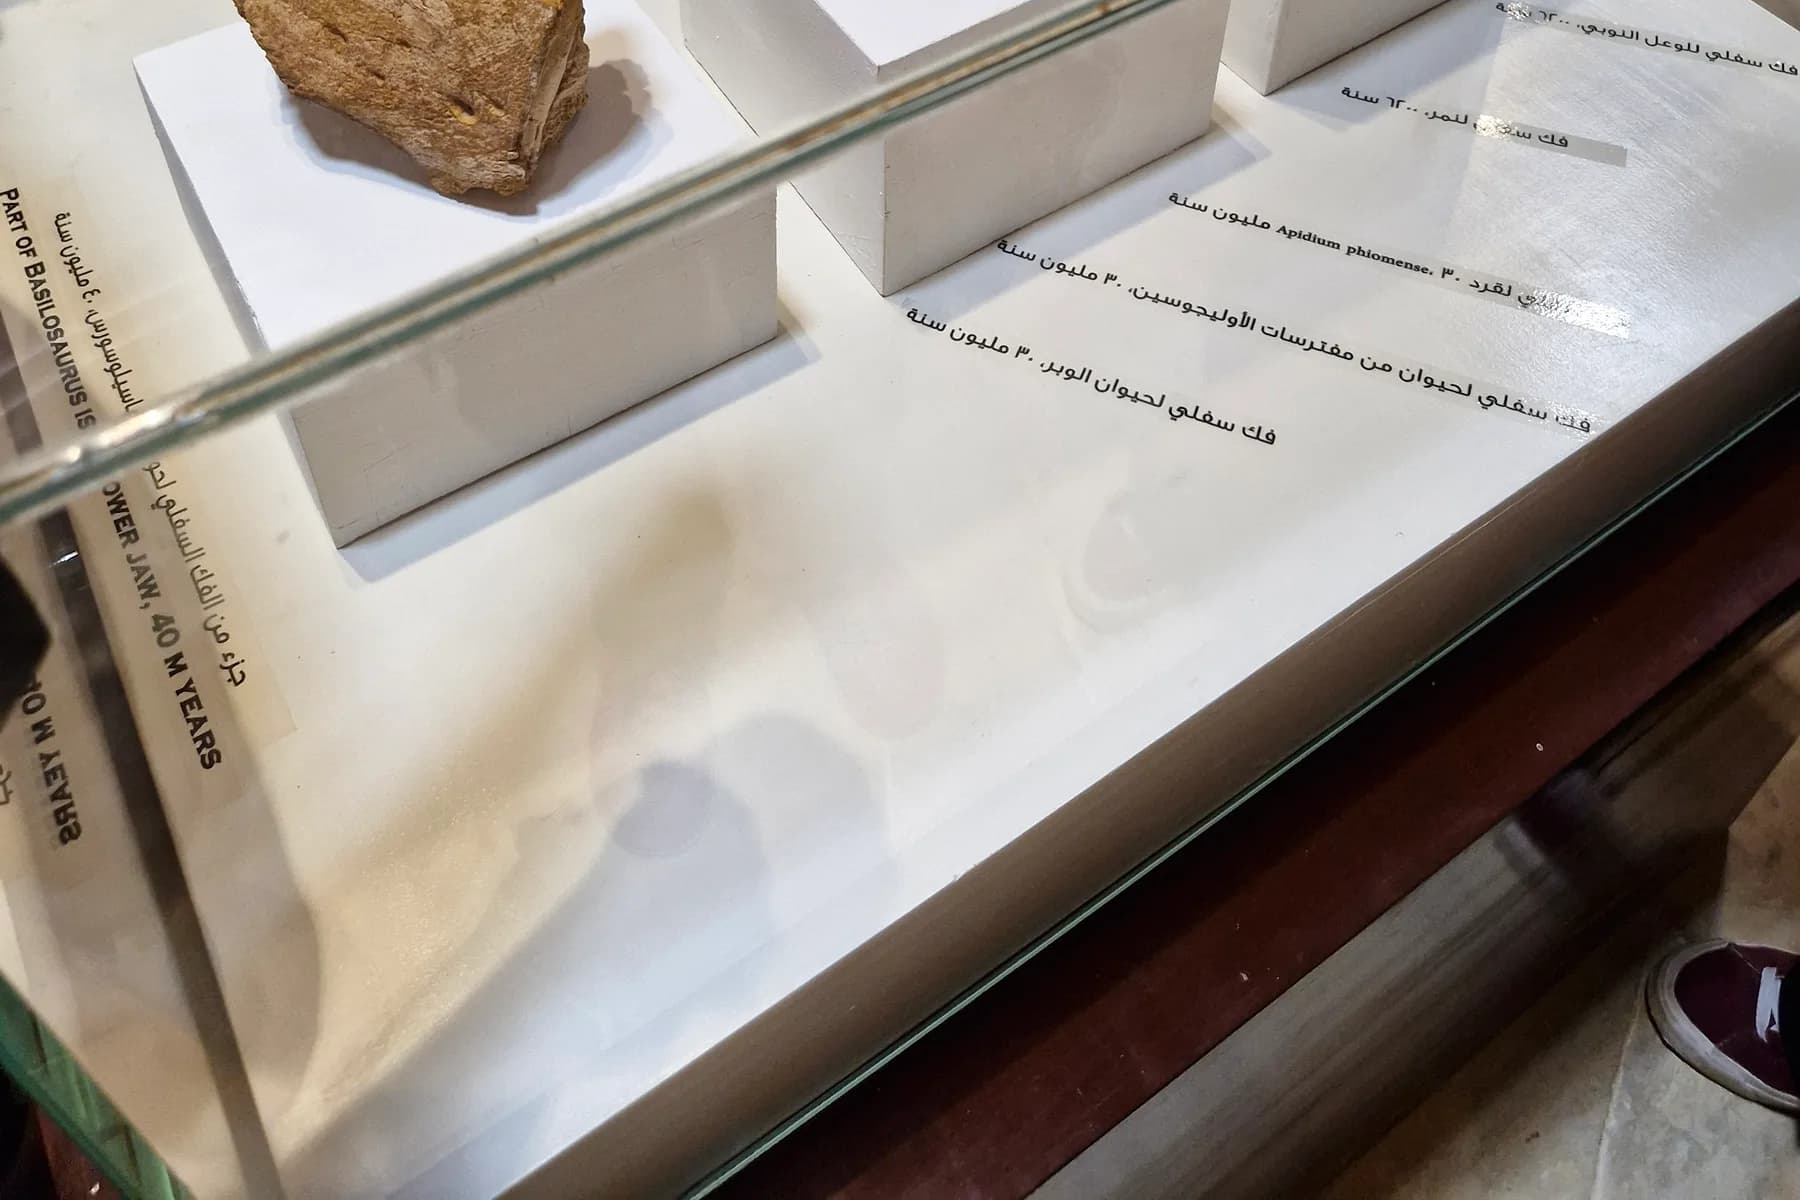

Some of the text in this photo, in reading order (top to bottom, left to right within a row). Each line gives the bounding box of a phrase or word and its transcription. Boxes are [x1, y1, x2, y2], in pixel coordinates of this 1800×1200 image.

[1644, 35, 1700, 54] للوعل
[1705, 50, 1763, 69] سفلي
[1768, 60, 1800, 77] فك
[1341, 85, 1380, 105] سنة
[1386, 96, 1418, 112] ٦٢٠٠
[1538, 132, 1569, 149] فك
[0, 187, 28, 233] PART
[1168, 191, 1208, 213] سنة
[54, 211, 74, 243] سنة
[1212, 207, 1271, 231] مليون
[16, 236, 37, 259] OF
[997, 238, 1036, 262] سنة
[1275, 224, 1341, 251] Apidium
[59, 244, 94, 288] مليون
[1039, 256, 1098, 281] مليون
[1103, 272, 1122, 287] ٣٠
[1441, 266, 1461, 282] ٣٠
[1468, 279, 1513, 297] لقرد
[906, 306, 948, 332] سنة
[24, 260, 88, 407] BASILOSAURUS
[949, 325, 1010, 355] مليون
[1260, 322, 1354, 361] مفترسات
[84, 308, 144, 412] اسيلوسورس،
[1014, 345, 1034, 362] ٣٠
[1359, 354, 1393, 373] من
[1094, 375, 1166, 409] لحيوان
[1398, 367, 1473, 397] لحيوان
[1168, 403, 1235, 433] سفلي
[1477, 393, 1548, 420] سفلي
[1241, 423, 1278, 447] فك
[150, 493, 206, 564] السفلي
[126, 552, 161, 610] JAW,
[190, 564, 226, 611] الفك
[151, 612, 181, 649] 40
[203, 613, 230, 644] من
[163, 650, 189, 678] M
[219, 650, 246, 687] جزء
[175, 677, 222, 770] YEARS
